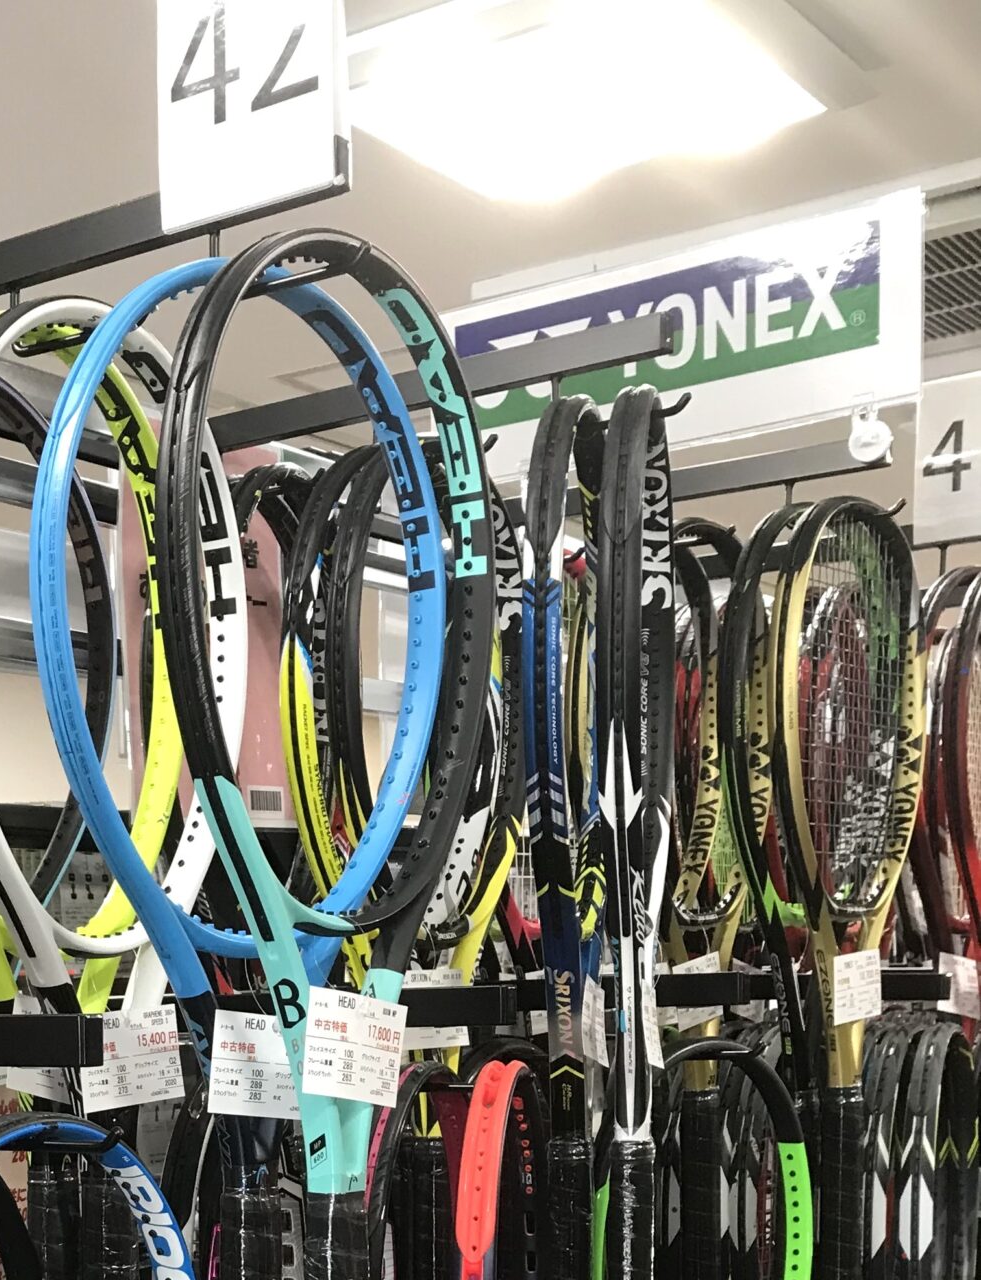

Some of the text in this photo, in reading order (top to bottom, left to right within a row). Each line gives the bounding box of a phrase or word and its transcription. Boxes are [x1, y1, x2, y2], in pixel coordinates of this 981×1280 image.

[608, 262, 847, 378] YONEX
[381, 289, 487, 577] HEAD
[302, 309, 435, 593] HEAD
[640, 436, 674, 610] SRIXON
[550, 617, 559, 765] SONIC CORE TECHNOLOGY
[640, 676, 650, 757] SONIC CORE
[890, 782, 918, 864] YONEX
[683, 799, 717, 876] YONEX
[338, 995, 356, 1009] HEAD
[554, 968, 575, 1049] SRIXON
[104, 1018, 120, 1029] HEAD
[245, 1018, 266, 1030] HEAD
[315, 1019, 400, 1045] 中古特価 17,600 円
[137, 1031, 177, 1047] 15,400 円
[221, 1041, 255, 1054] 中古特価
[344, 1050, 354, 1058] 100
[250, 1081, 262, 1089] 289
[252, 1069, 263, 1077] 100
[249, 1092, 261, 1100] 283
